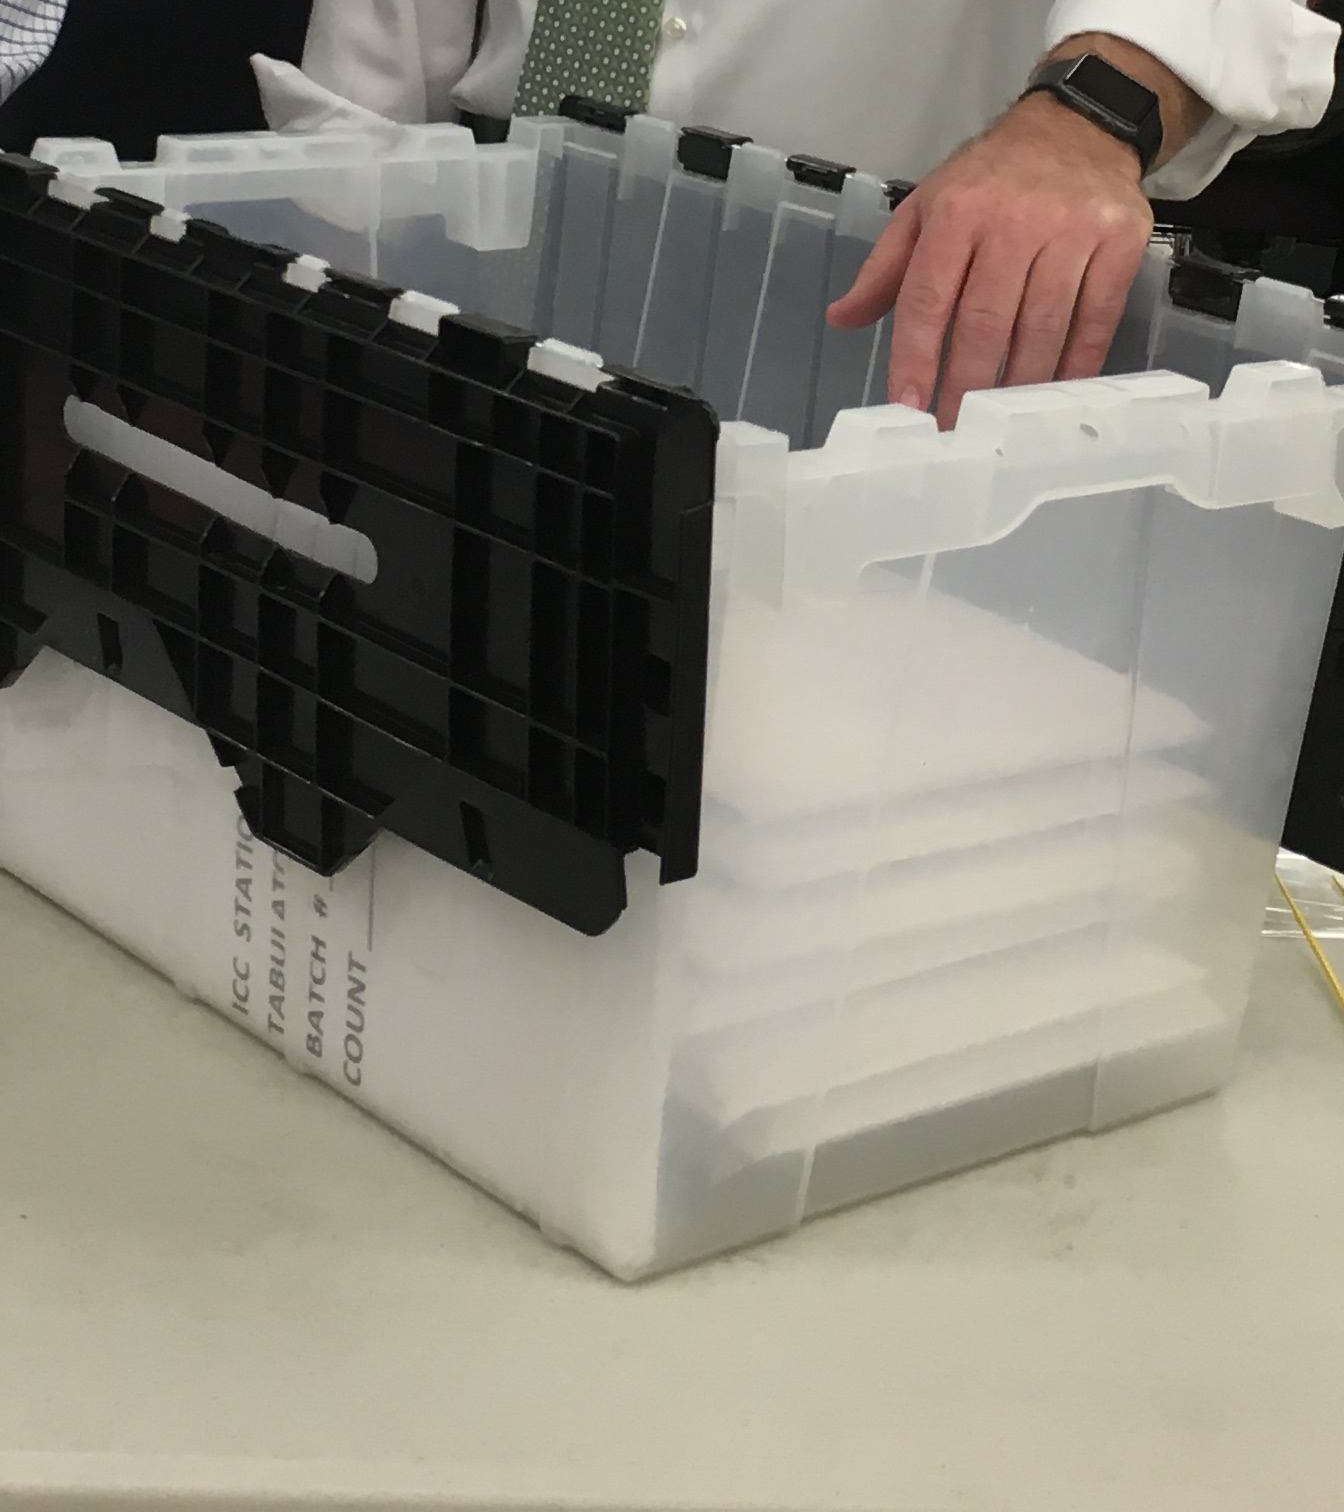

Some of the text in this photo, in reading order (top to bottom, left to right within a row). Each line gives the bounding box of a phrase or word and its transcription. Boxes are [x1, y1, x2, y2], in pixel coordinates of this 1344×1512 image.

[231, 956, 251, 1016] ICC
[305, 893, 329, 1059] BATCH #
[342, 950, 368, 1088] COUNT
